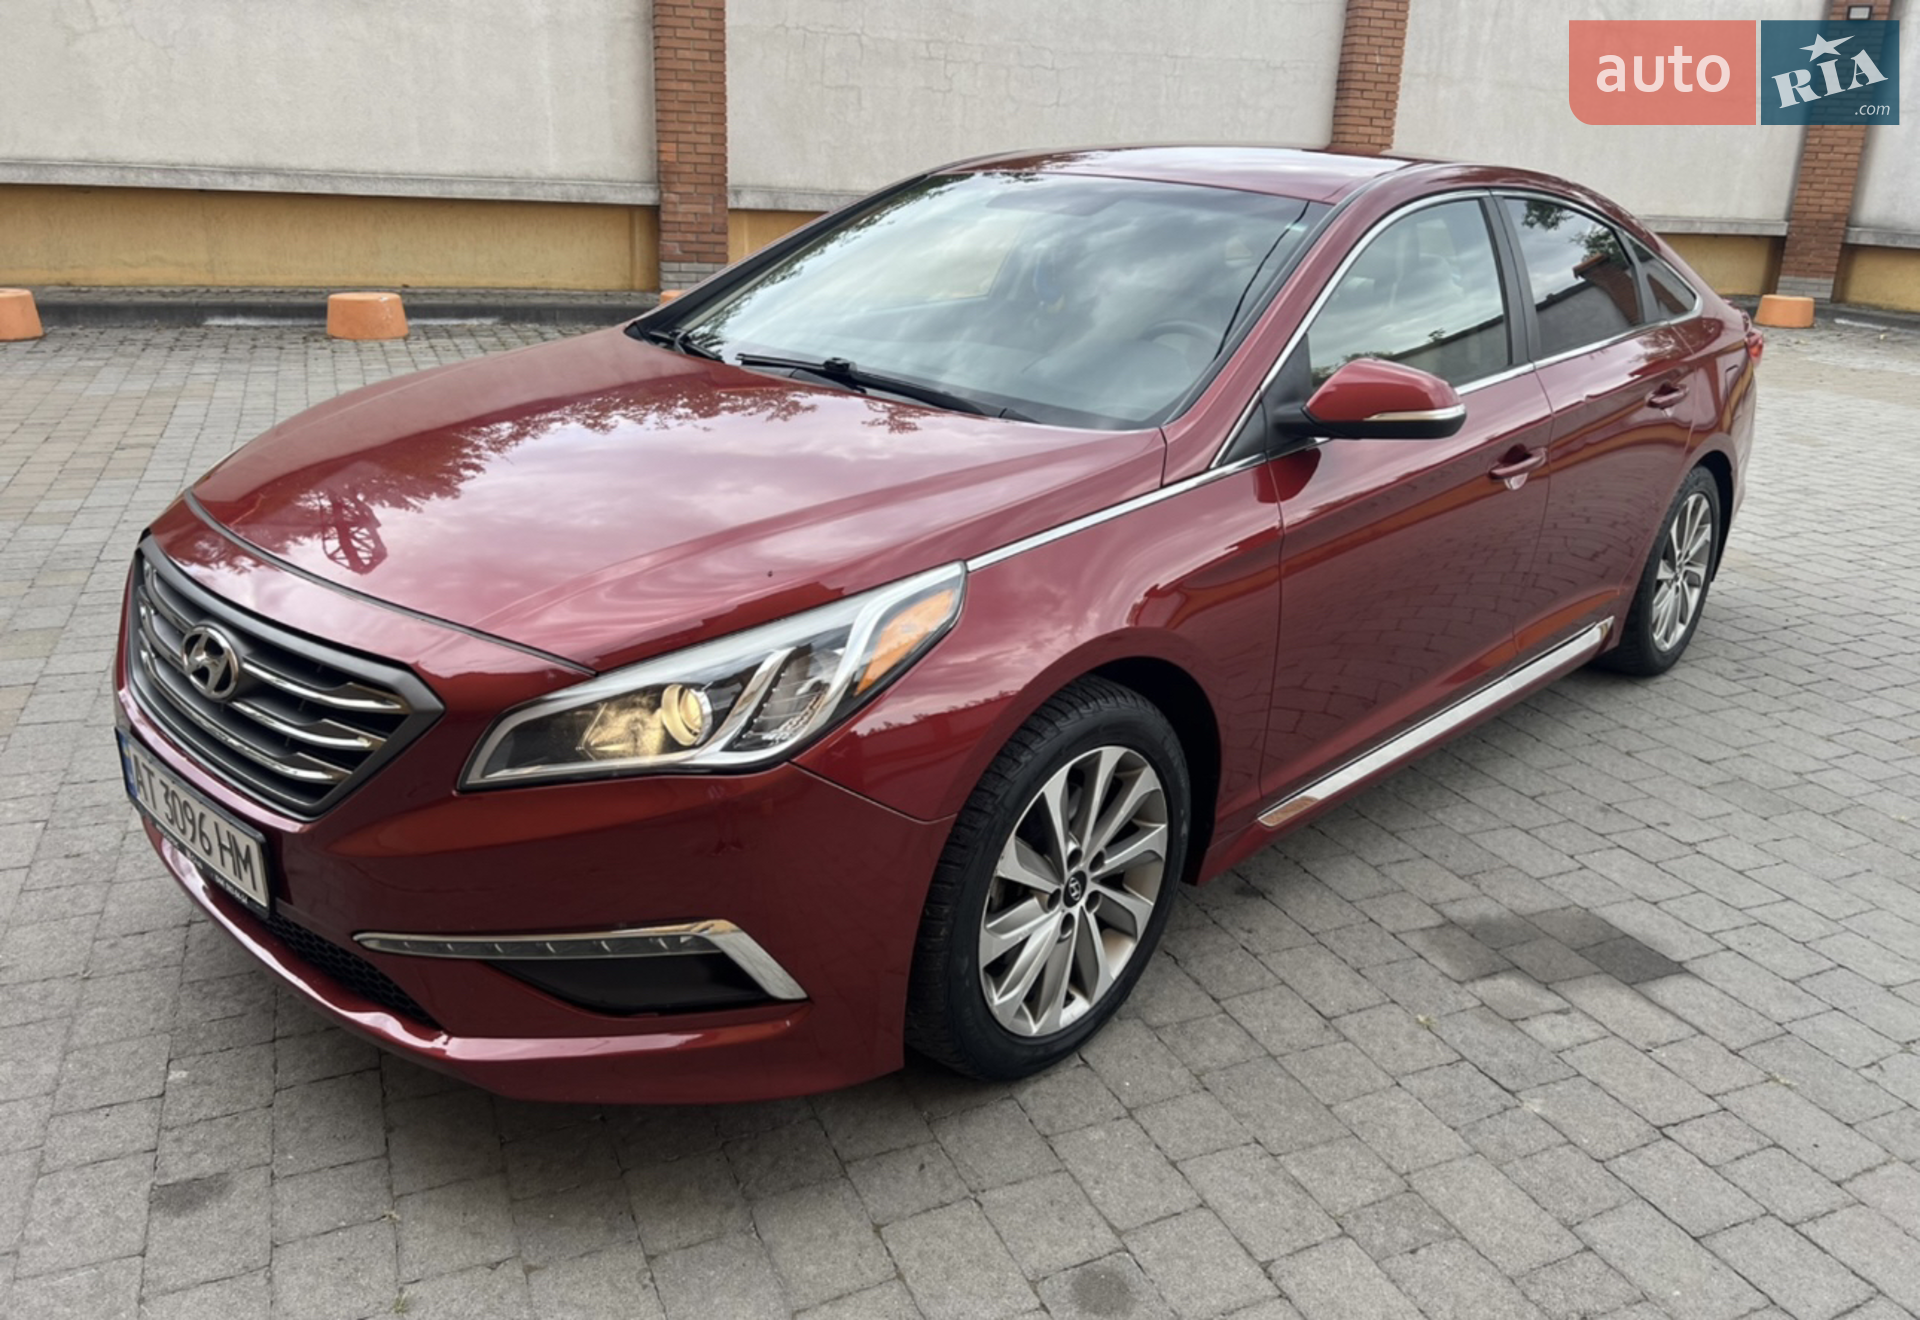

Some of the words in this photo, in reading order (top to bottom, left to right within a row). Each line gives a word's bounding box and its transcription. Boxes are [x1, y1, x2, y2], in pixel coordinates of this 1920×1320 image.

[133, 753, 157, 811] AT
[160, 780, 213, 857] 3096
[214, 821, 257, 891] HM
